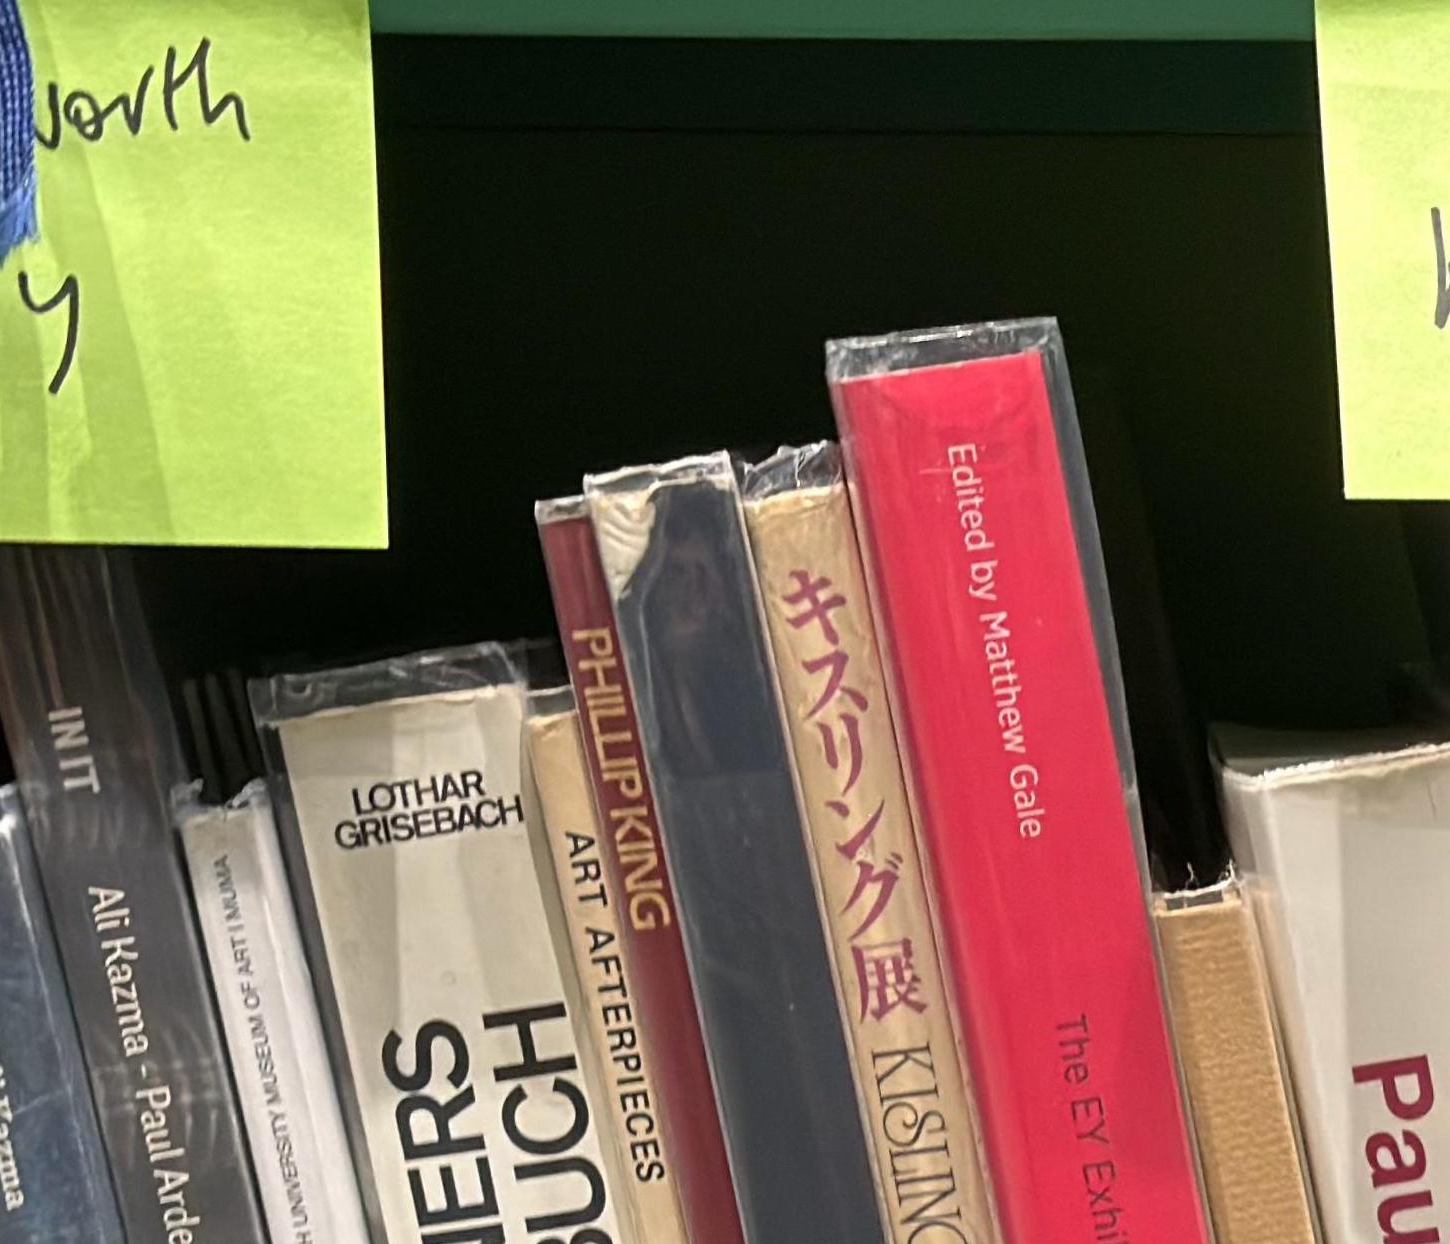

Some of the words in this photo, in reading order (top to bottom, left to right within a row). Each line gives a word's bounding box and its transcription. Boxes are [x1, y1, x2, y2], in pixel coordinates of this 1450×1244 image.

[946, 442, 994, 552] Edited
[967, 558, 999, 602] by
[978, 609, 1027, 755] Matthew
[46, 705, 91, 752] IN
[57, 754, 102, 795] IT
[351, 769, 485, 816] LOTHAR
[570, 626, 645, 800] PHILLIP
[608, 804, 672, 932] KING
[781, 567, 929, 1024] キスリング展
[1008, 762, 1046, 839] Gale
[334, 794, 526, 850] GRISEBACH
[211, 852, 242, 923] MUMA
[564, 830, 609, 909] ART
[86, 885, 131, 934] Ali
[228, 934, 256, 978] ART
[99, 934, 150, 1058] Kazma
[239, 980, 262, 1012] OF
[246, 1012, 283, 1106] MUSEUM
[583, 921, 666, 1184] AFTERPIECES
[1054, 1012, 1094, 1086] The
[133, 1084, 186, 1163] Paul
[1068, 1095, 1110, 1146] EY
[267, 1109, 310, 1228] UNIVERSITY
